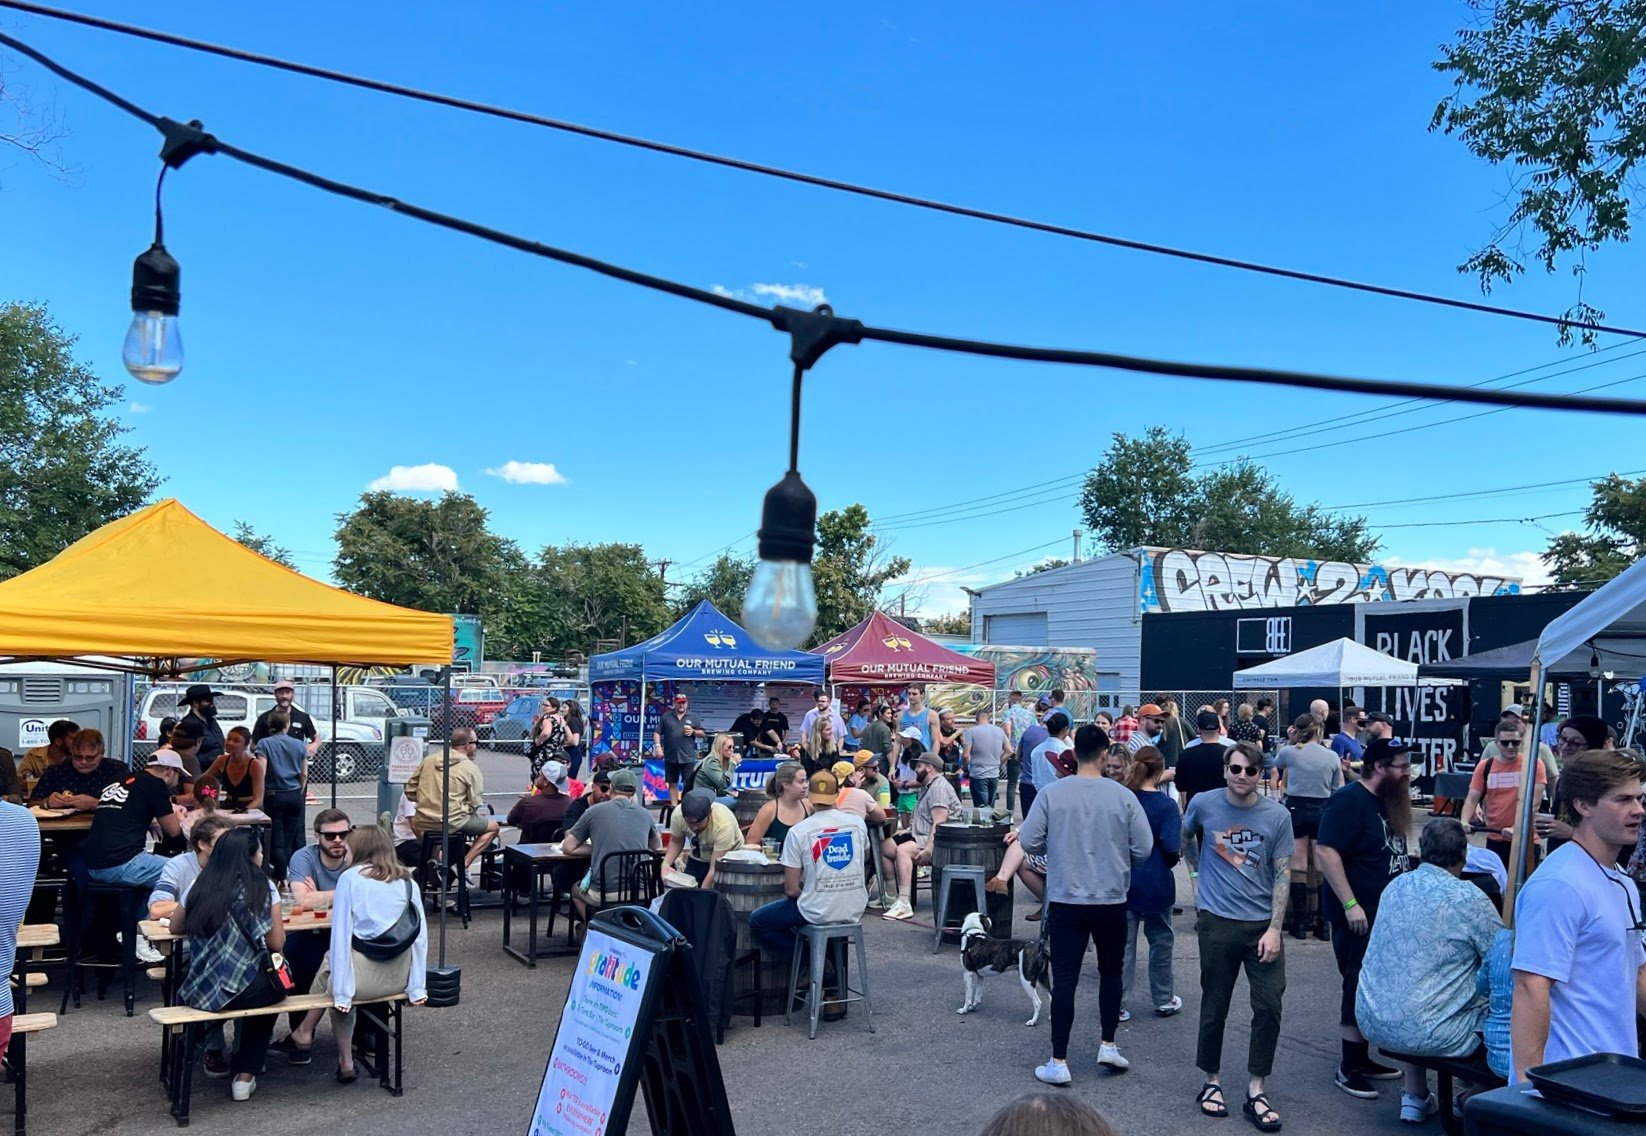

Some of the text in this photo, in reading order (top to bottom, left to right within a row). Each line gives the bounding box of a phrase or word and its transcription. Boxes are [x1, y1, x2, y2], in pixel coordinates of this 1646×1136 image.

[676, 658, 796, 670] OUR MUTUAL FRIEND
[861, 663, 970, 675] OUR MUTUAL FRIEND
